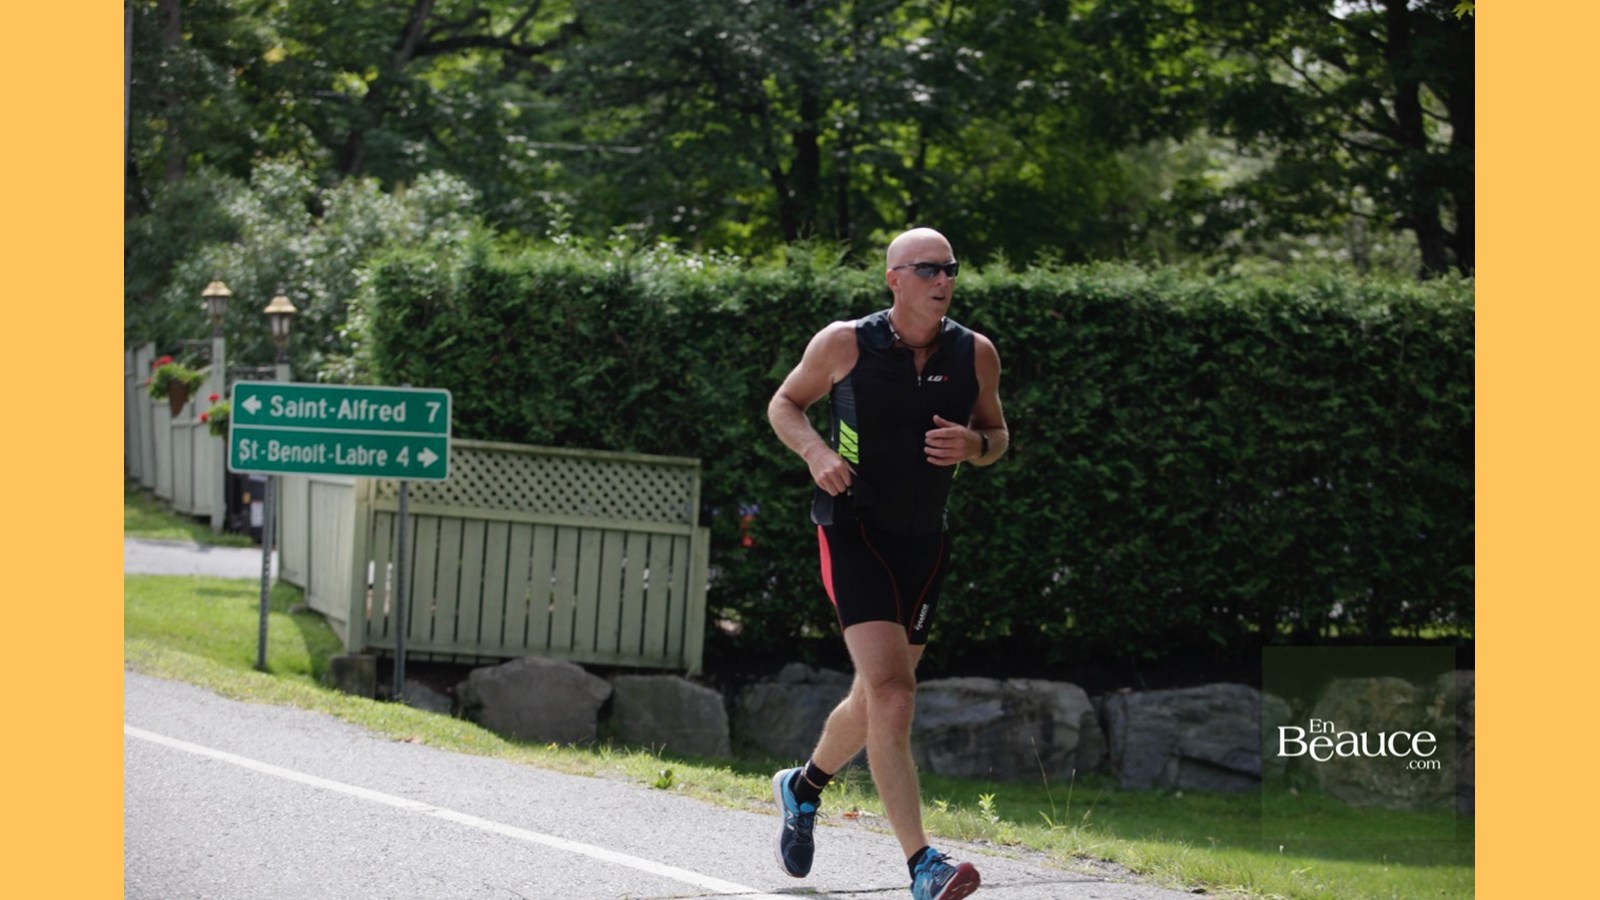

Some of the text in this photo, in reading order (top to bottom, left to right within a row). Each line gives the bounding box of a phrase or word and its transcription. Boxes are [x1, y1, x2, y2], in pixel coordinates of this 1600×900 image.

[927, 375, 943, 383] LG
[270, 395, 441, 423] Saint-Alfred 7
[396, 446, 409, 467] 4
